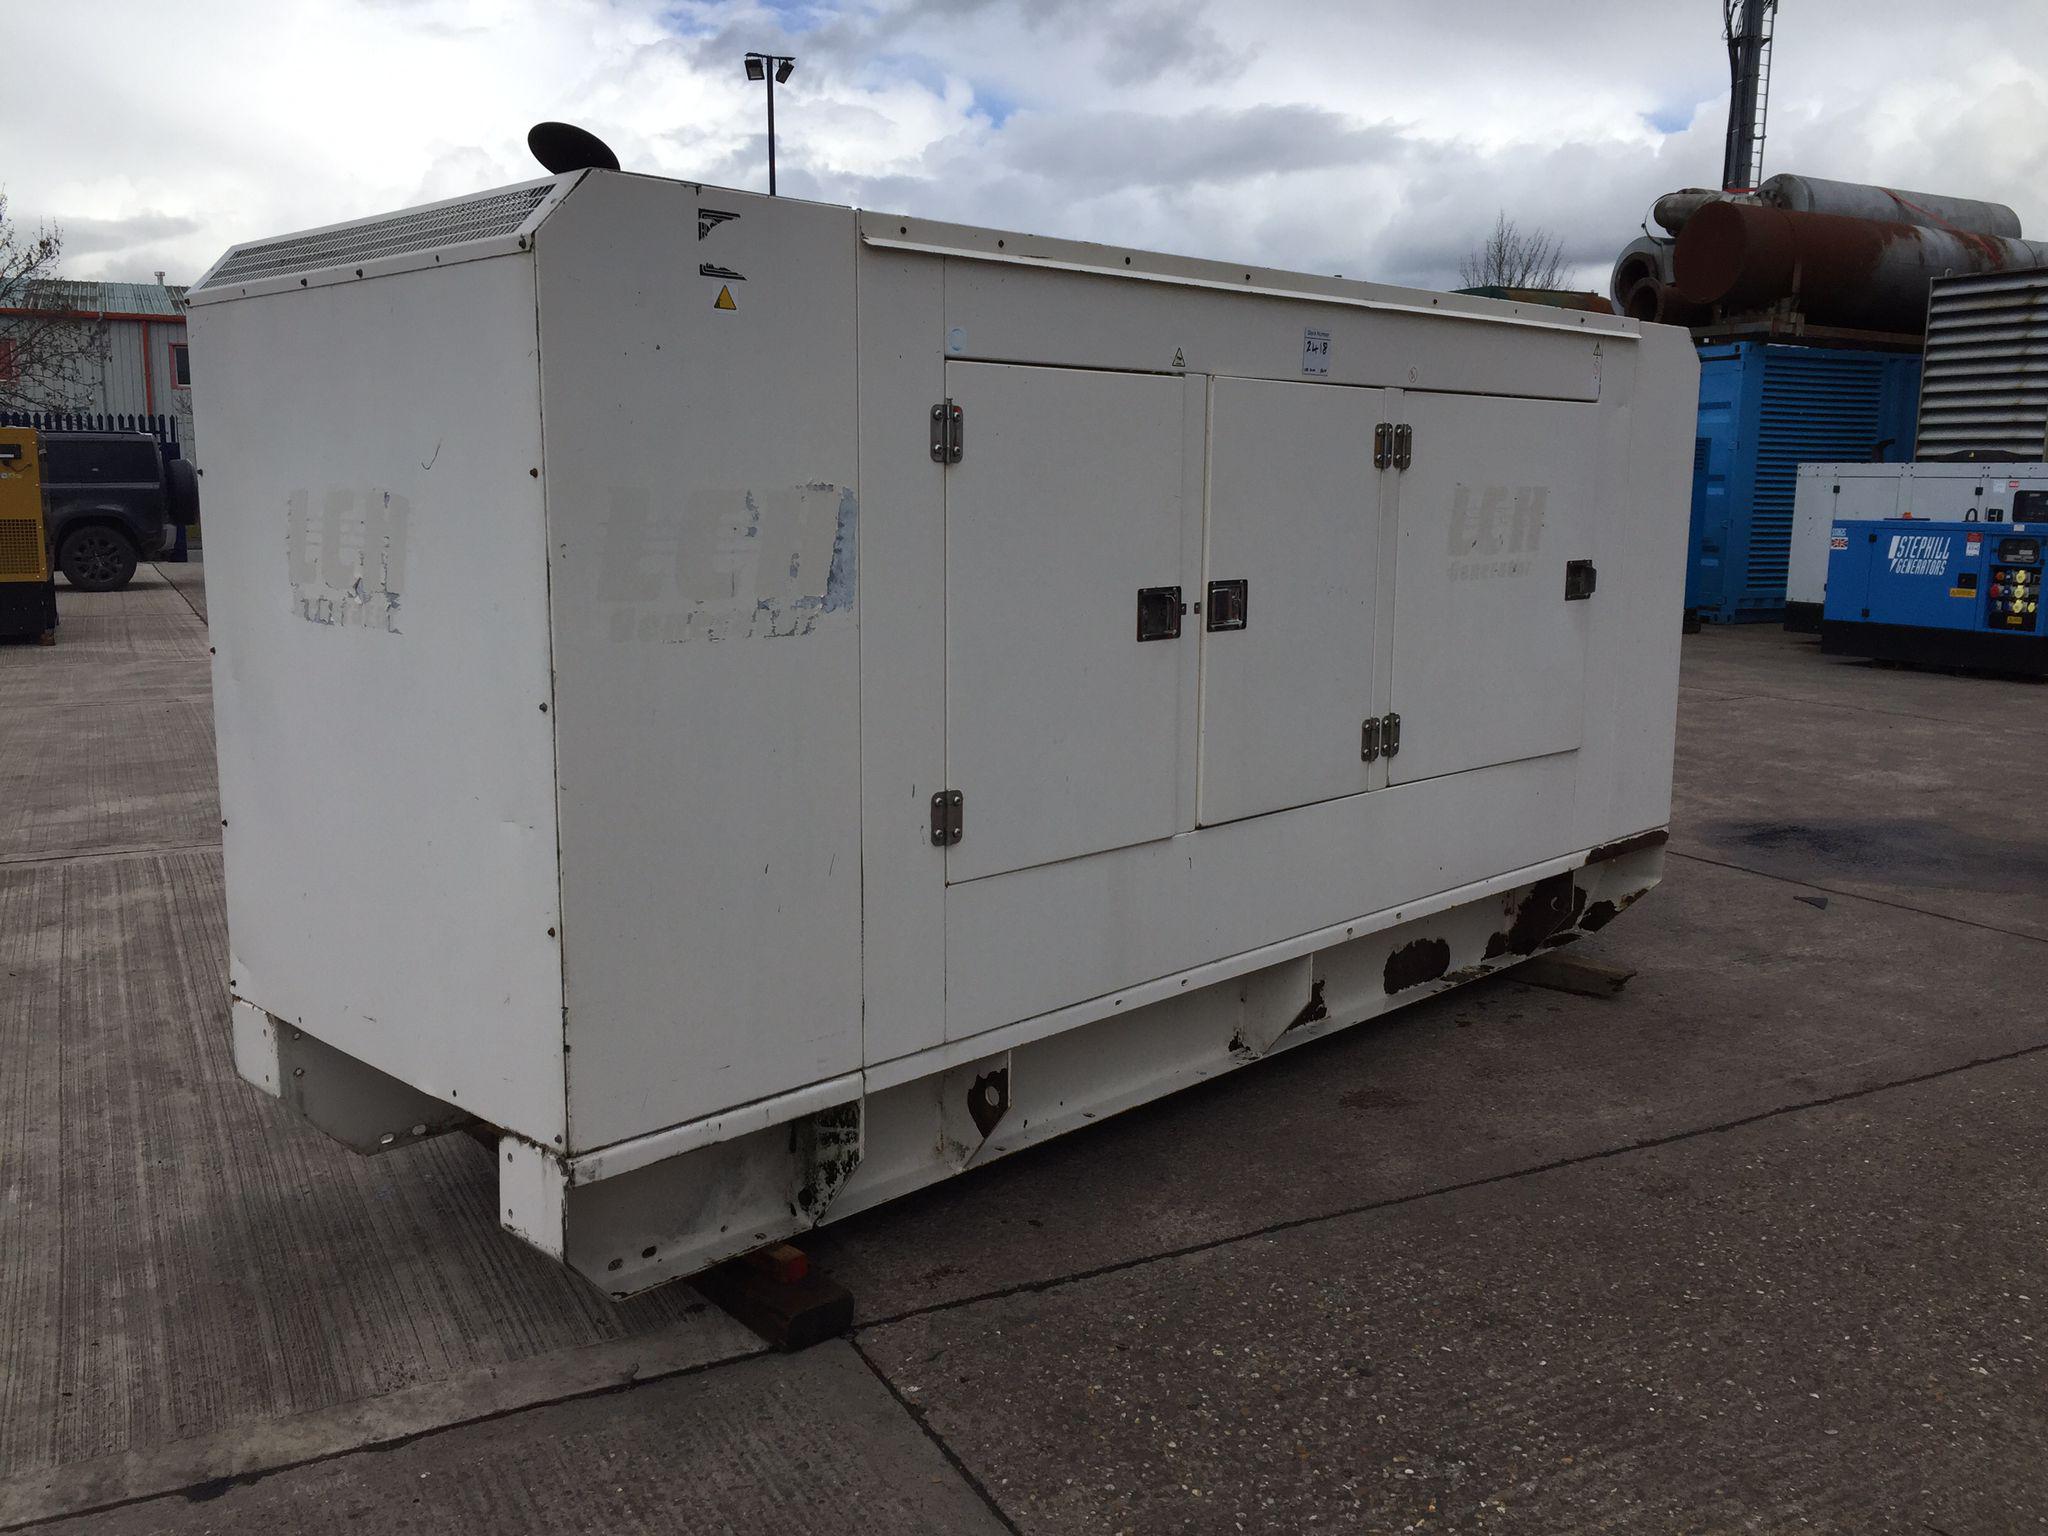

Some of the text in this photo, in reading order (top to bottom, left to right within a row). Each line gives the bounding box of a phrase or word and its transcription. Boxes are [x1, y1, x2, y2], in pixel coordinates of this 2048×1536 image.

[1306, 340, 1328, 355] 2418
[1896, 535, 1951, 560] STEPHILL
[1895, 559, 1947, 575] GENERATORS
